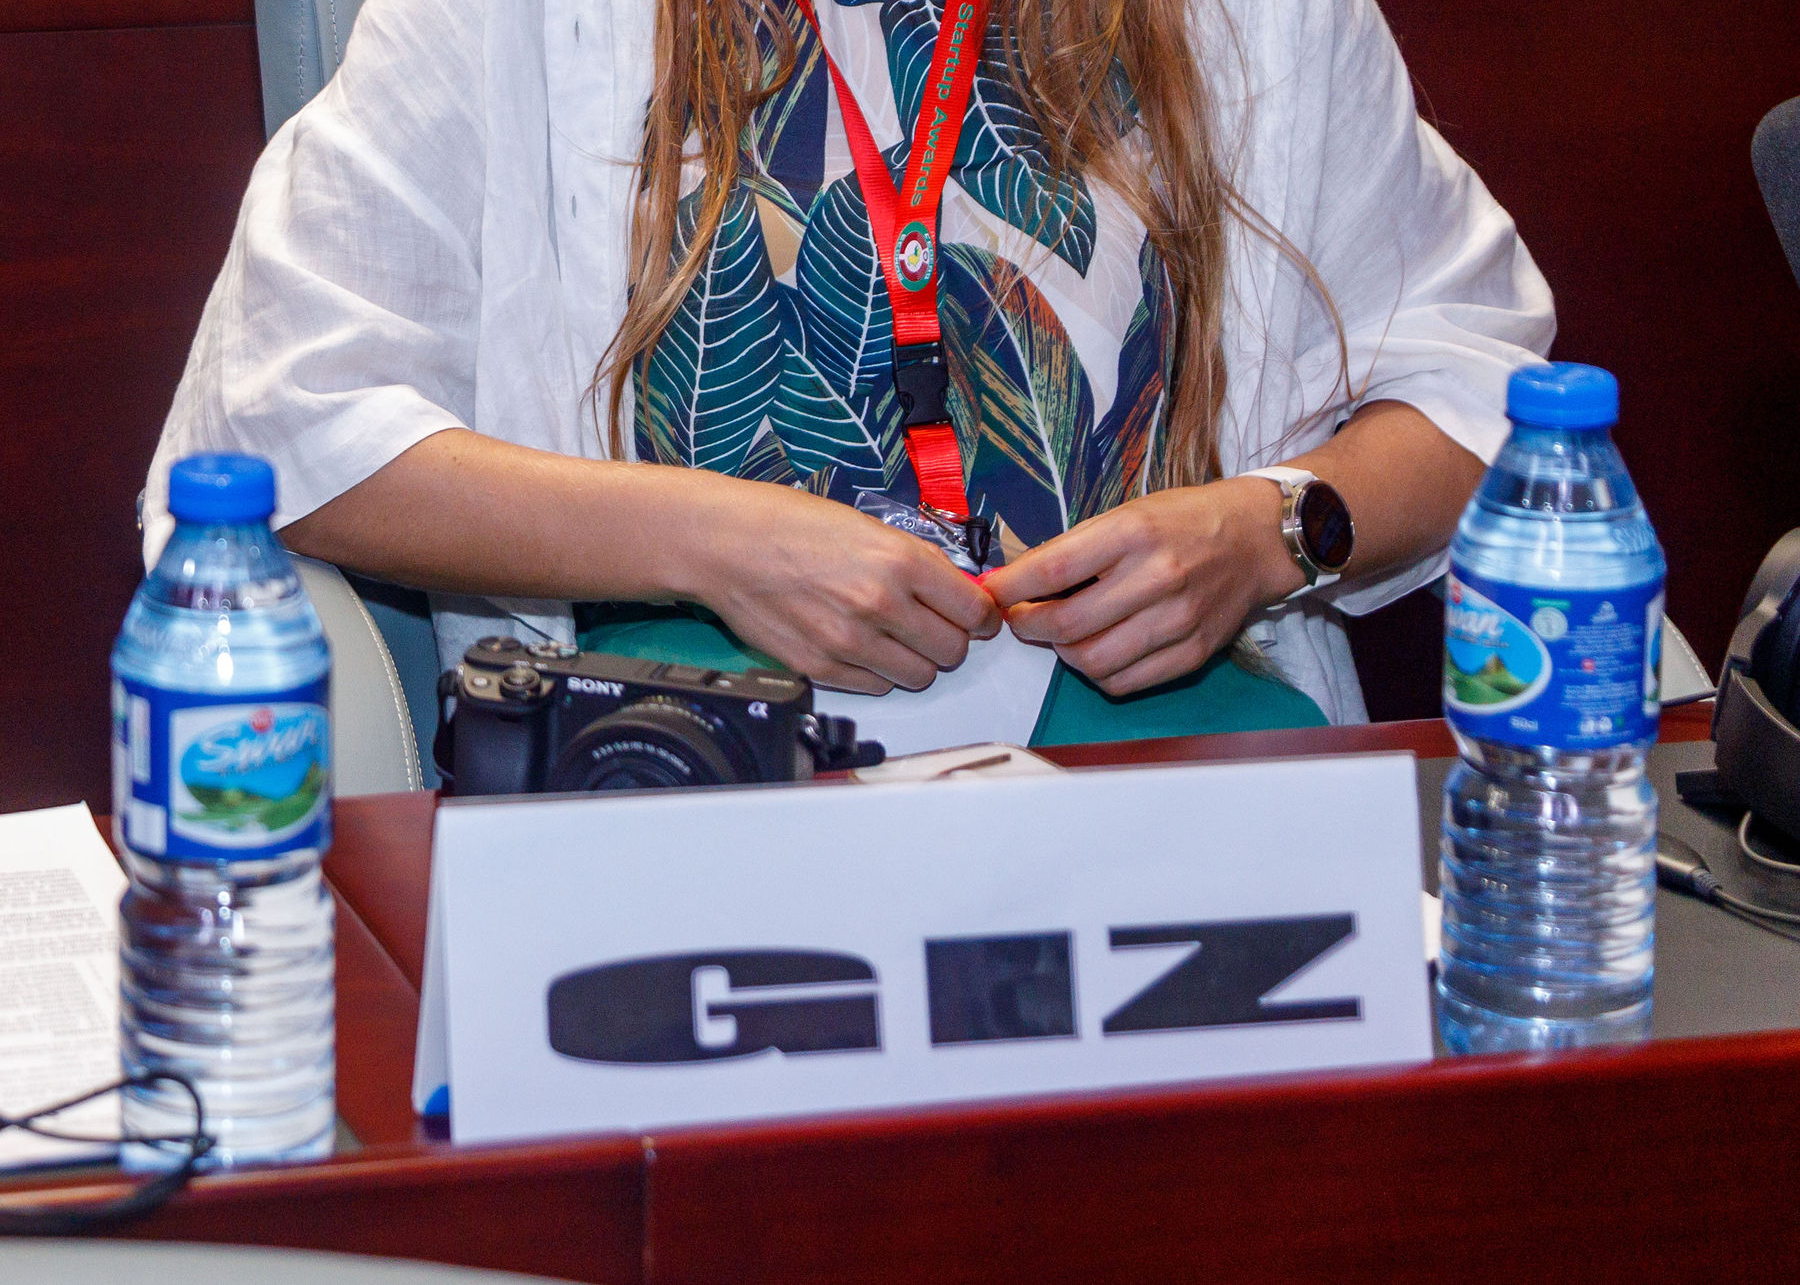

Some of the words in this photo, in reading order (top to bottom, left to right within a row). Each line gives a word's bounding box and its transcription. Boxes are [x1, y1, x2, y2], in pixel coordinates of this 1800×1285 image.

[937, 2, 974, 100] Startup
[911, 106, 948, 207] Awards
[566, 676, 625, 698] SONY
[547, 911, 1363, 1067] GIZ
